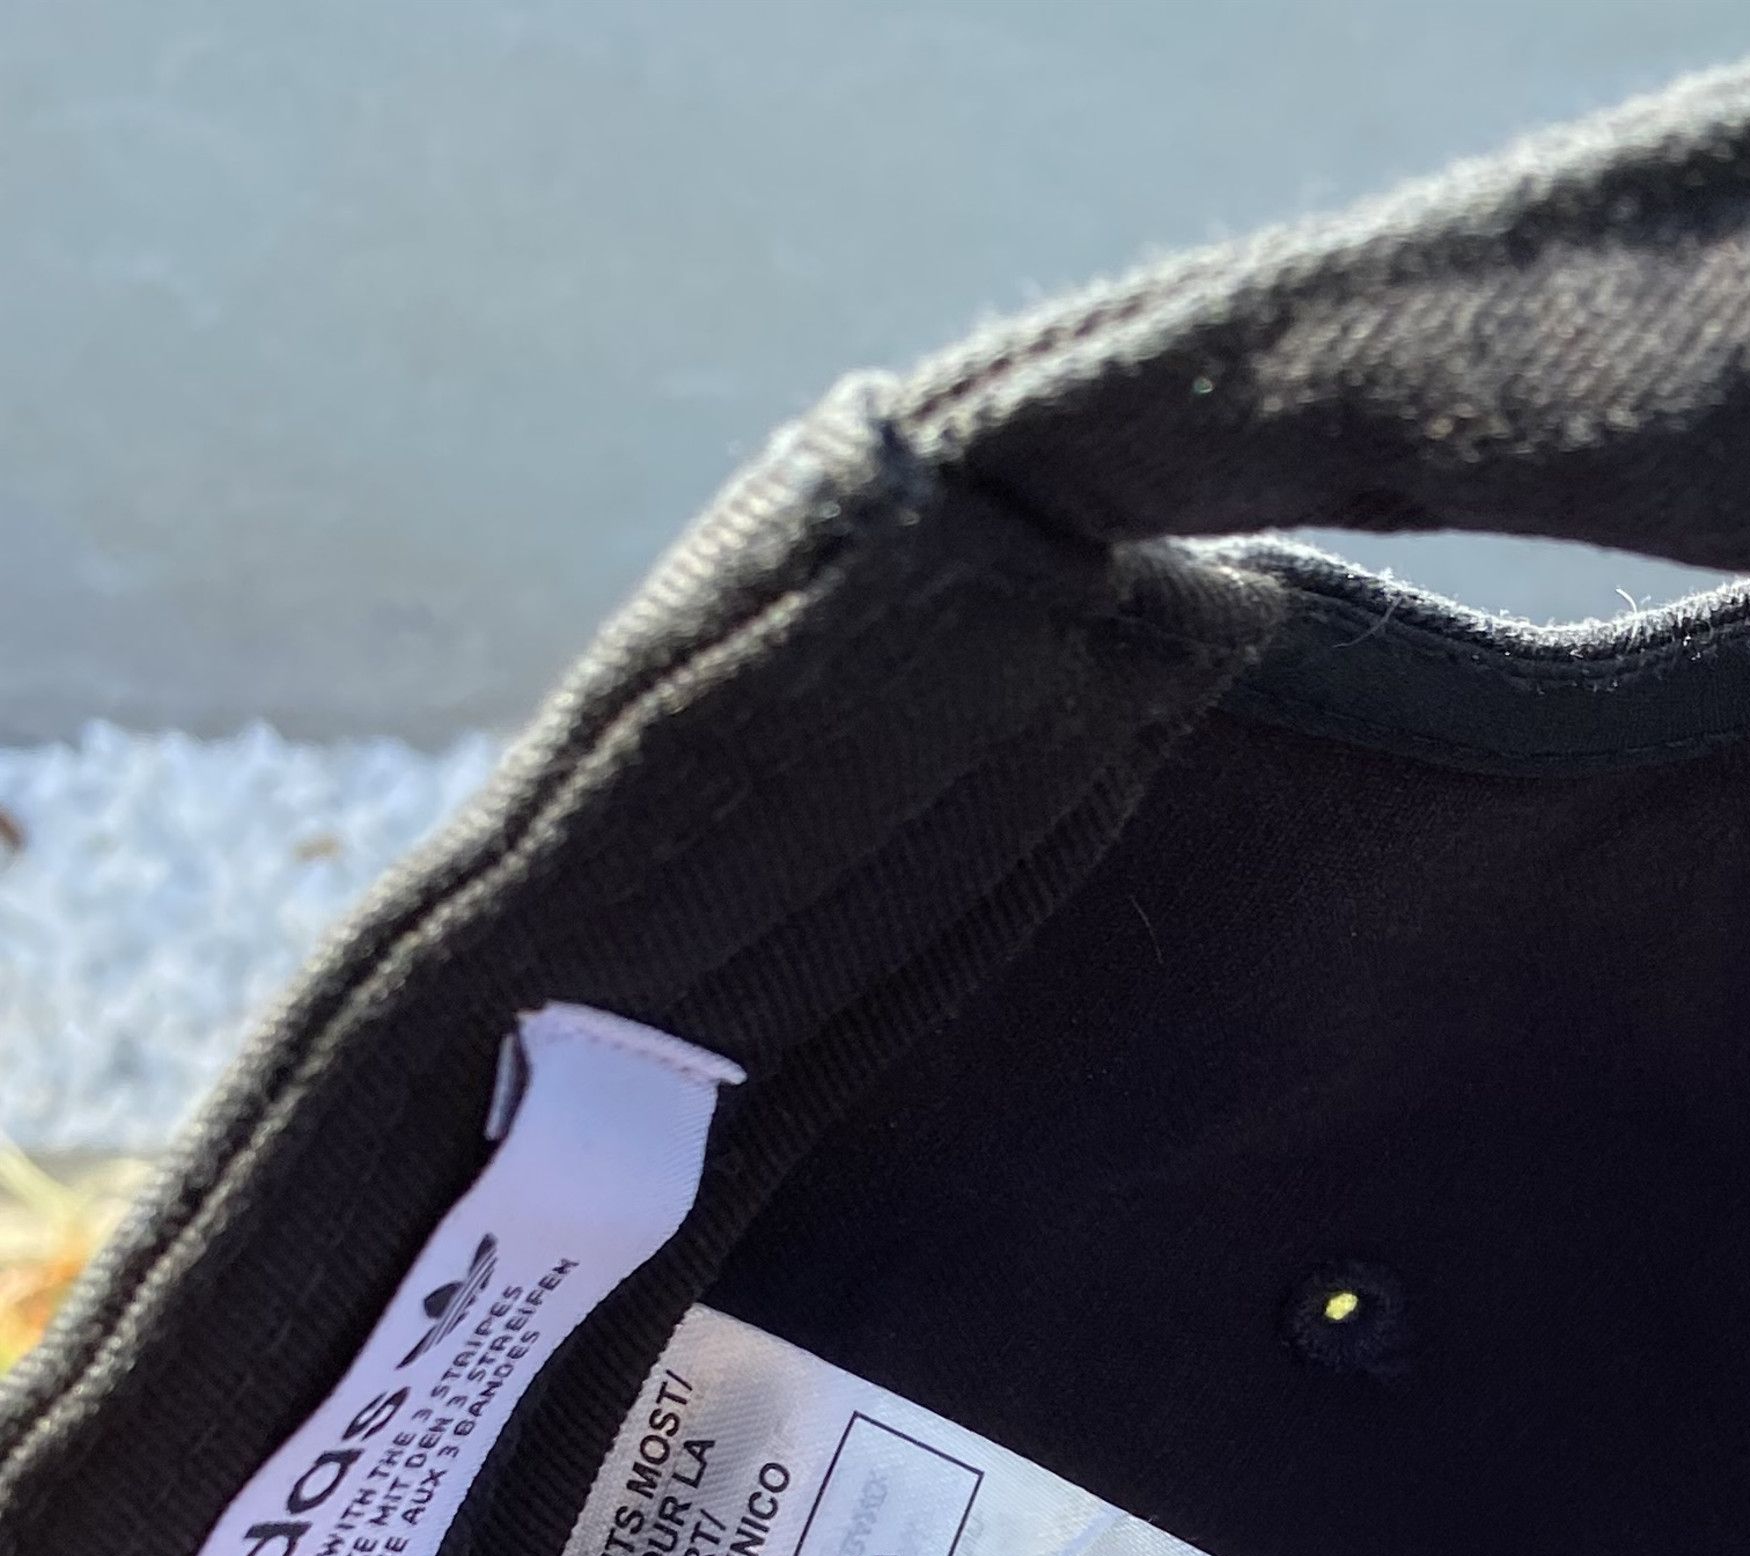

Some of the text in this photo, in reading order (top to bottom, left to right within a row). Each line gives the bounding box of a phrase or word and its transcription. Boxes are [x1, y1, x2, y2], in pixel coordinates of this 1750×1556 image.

[366, 1431, 416, 1479] THE
[410, 1407, 435, 1423] 3
[367, 1475, 411, 1528] MIT
[403, 1417, 454, 1469] DEN
[444, 1394, 470, 1410] 3
[400, 1468, 447, 1526] AUX
[436, 1444, 461, 1460] 3
[453, 1331, 540, 1437] BANDES
[625, 1369, 693, 1501] MOST/
[669, 1438, 717, 1490] LA
